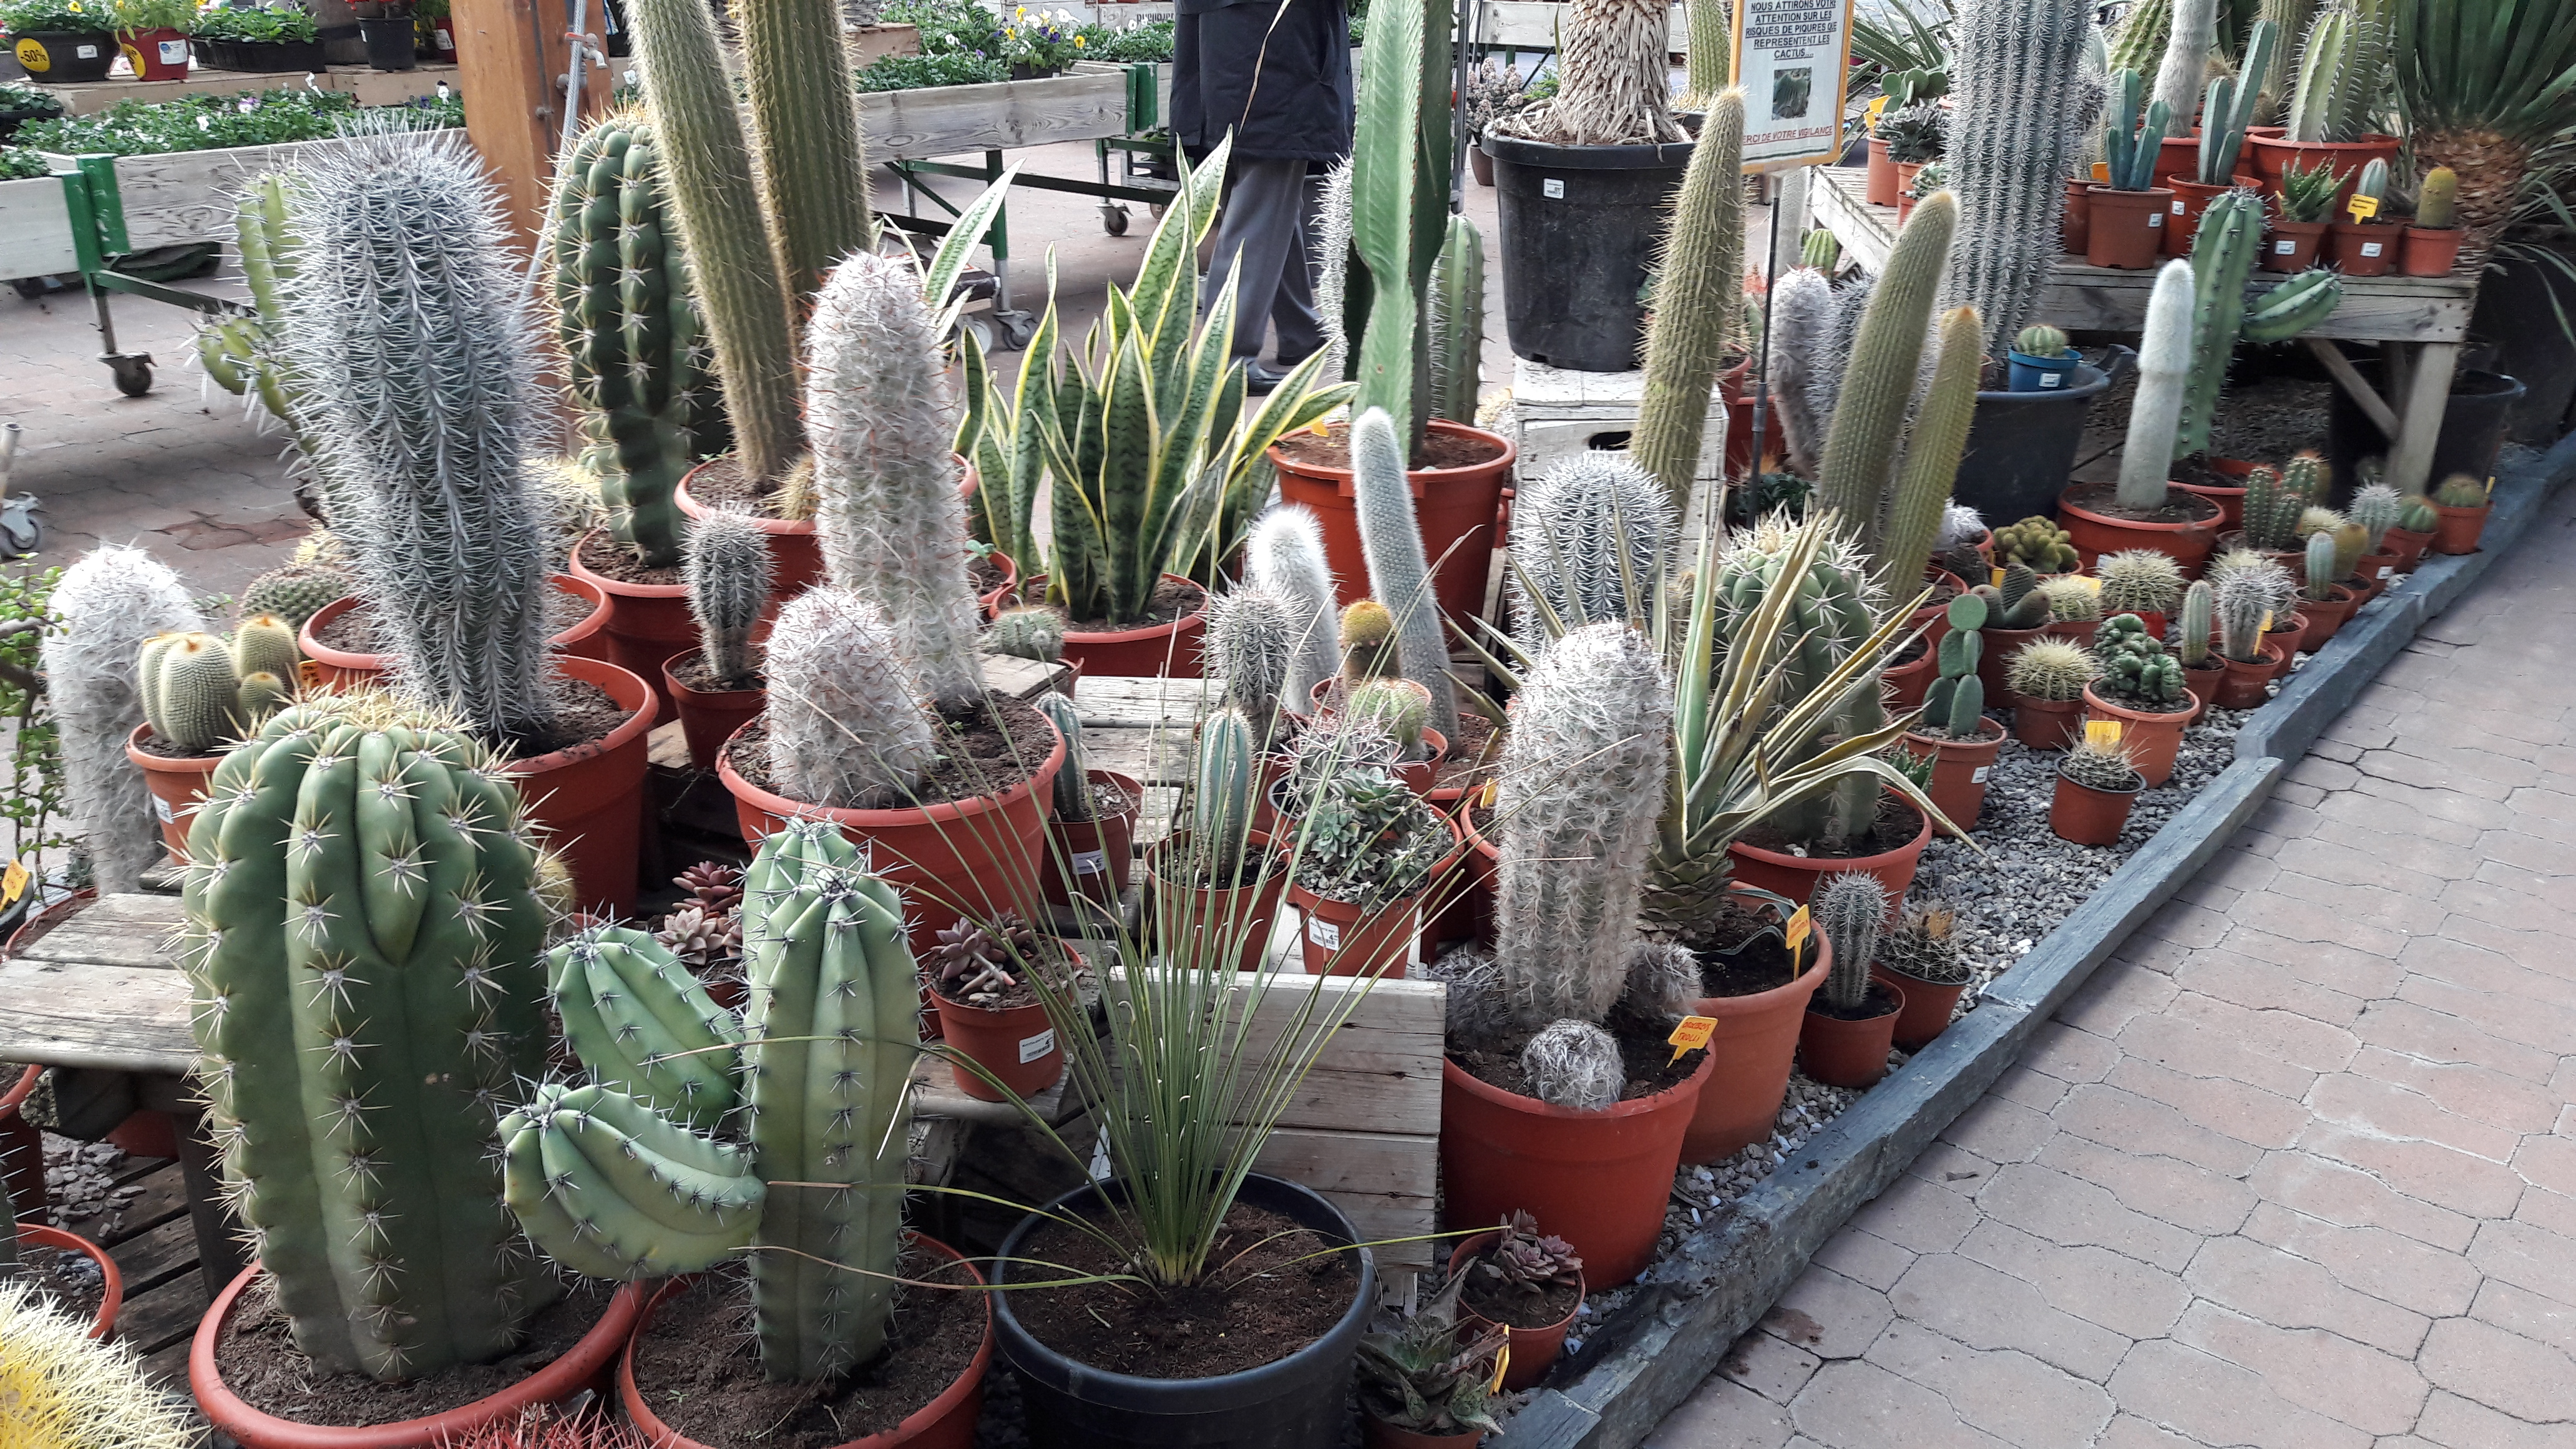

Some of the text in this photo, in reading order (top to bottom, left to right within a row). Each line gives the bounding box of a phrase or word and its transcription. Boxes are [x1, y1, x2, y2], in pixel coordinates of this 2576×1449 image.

[1751, 2, 1773, 11] NOUS
[1775, 0, 1813, 10] ATTIRONS
[1755, 11, 1832, 23] ATTENTION SUR LES
[1746, 22, 1838, 36] RISQUES DE PIQURES QUE
[1754, 34, 1830, 47] REPRESENTENT LES
[1743, 125, 1833, 143] ERCI DE VOTRE VIGILANCE
